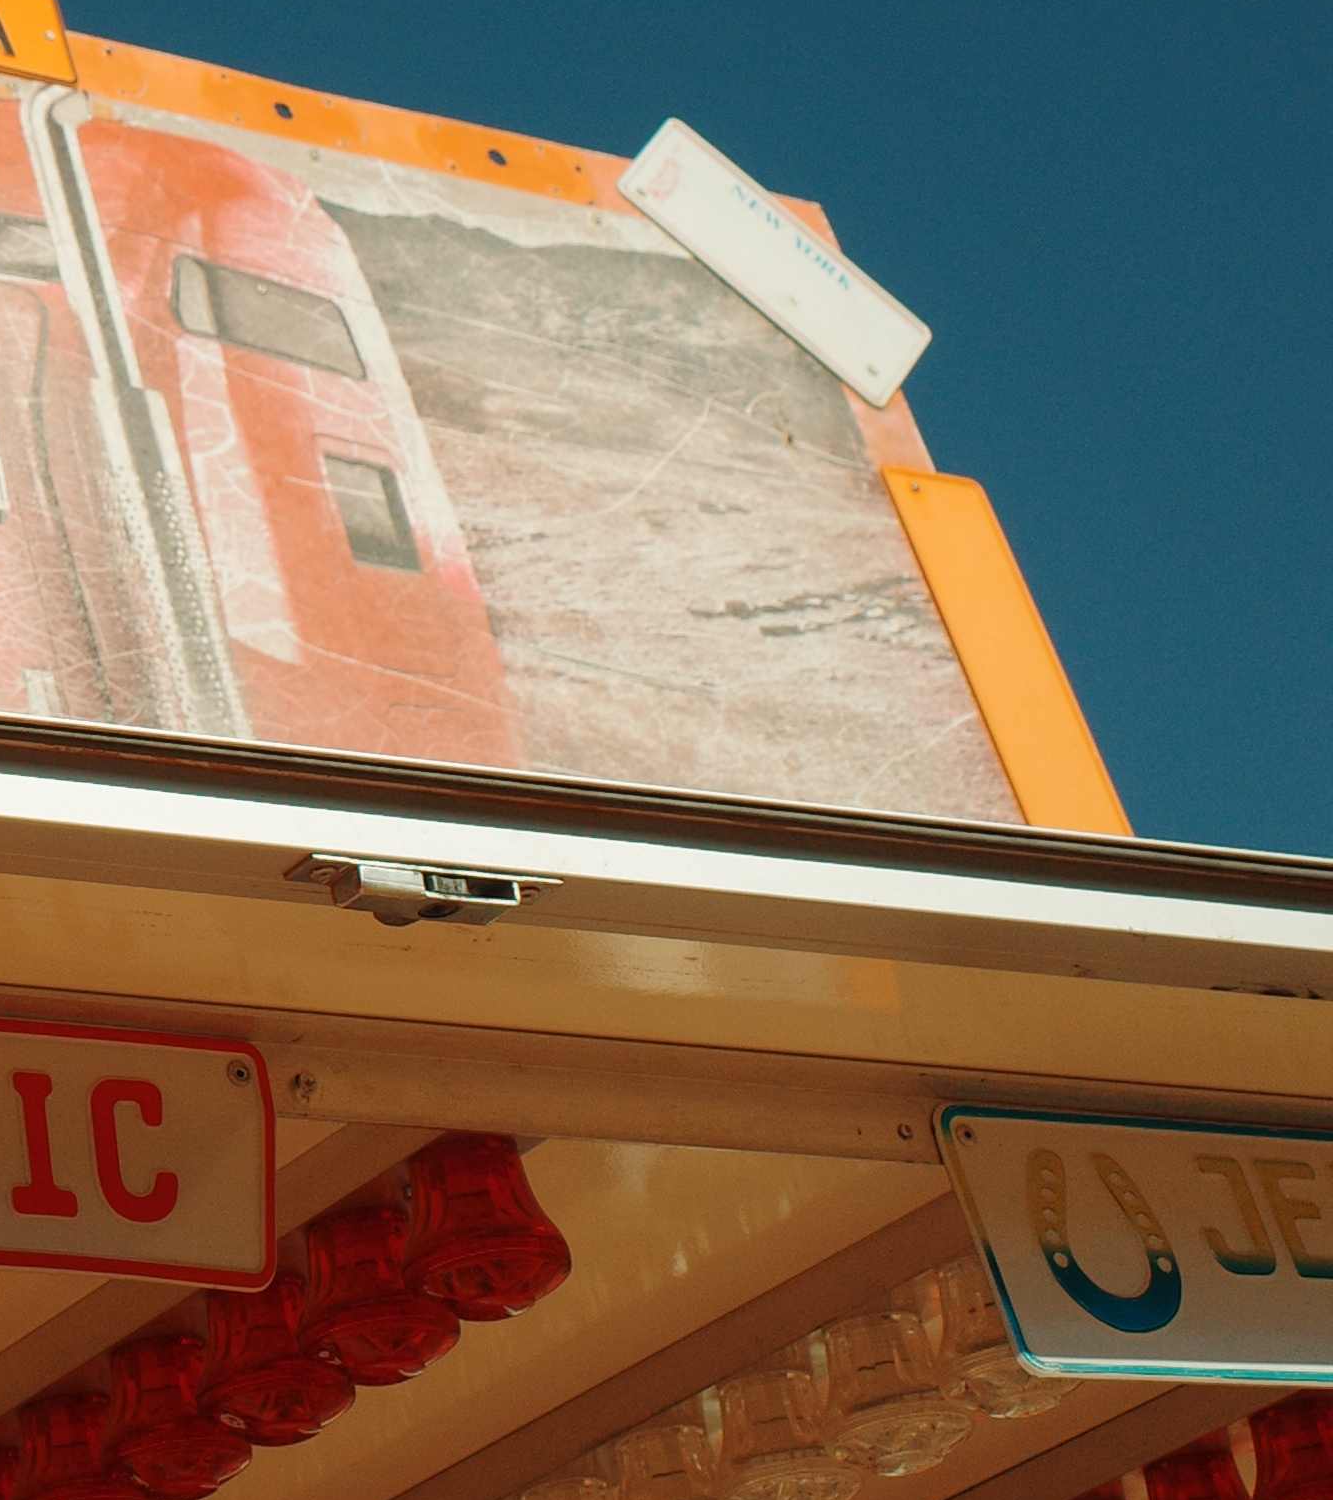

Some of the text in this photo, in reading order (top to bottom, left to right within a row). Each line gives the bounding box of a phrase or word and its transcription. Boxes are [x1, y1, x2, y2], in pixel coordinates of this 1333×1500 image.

[731, 183, 852, 291] NEW YORK
[1194, 1152, 1333, 1280] JE
